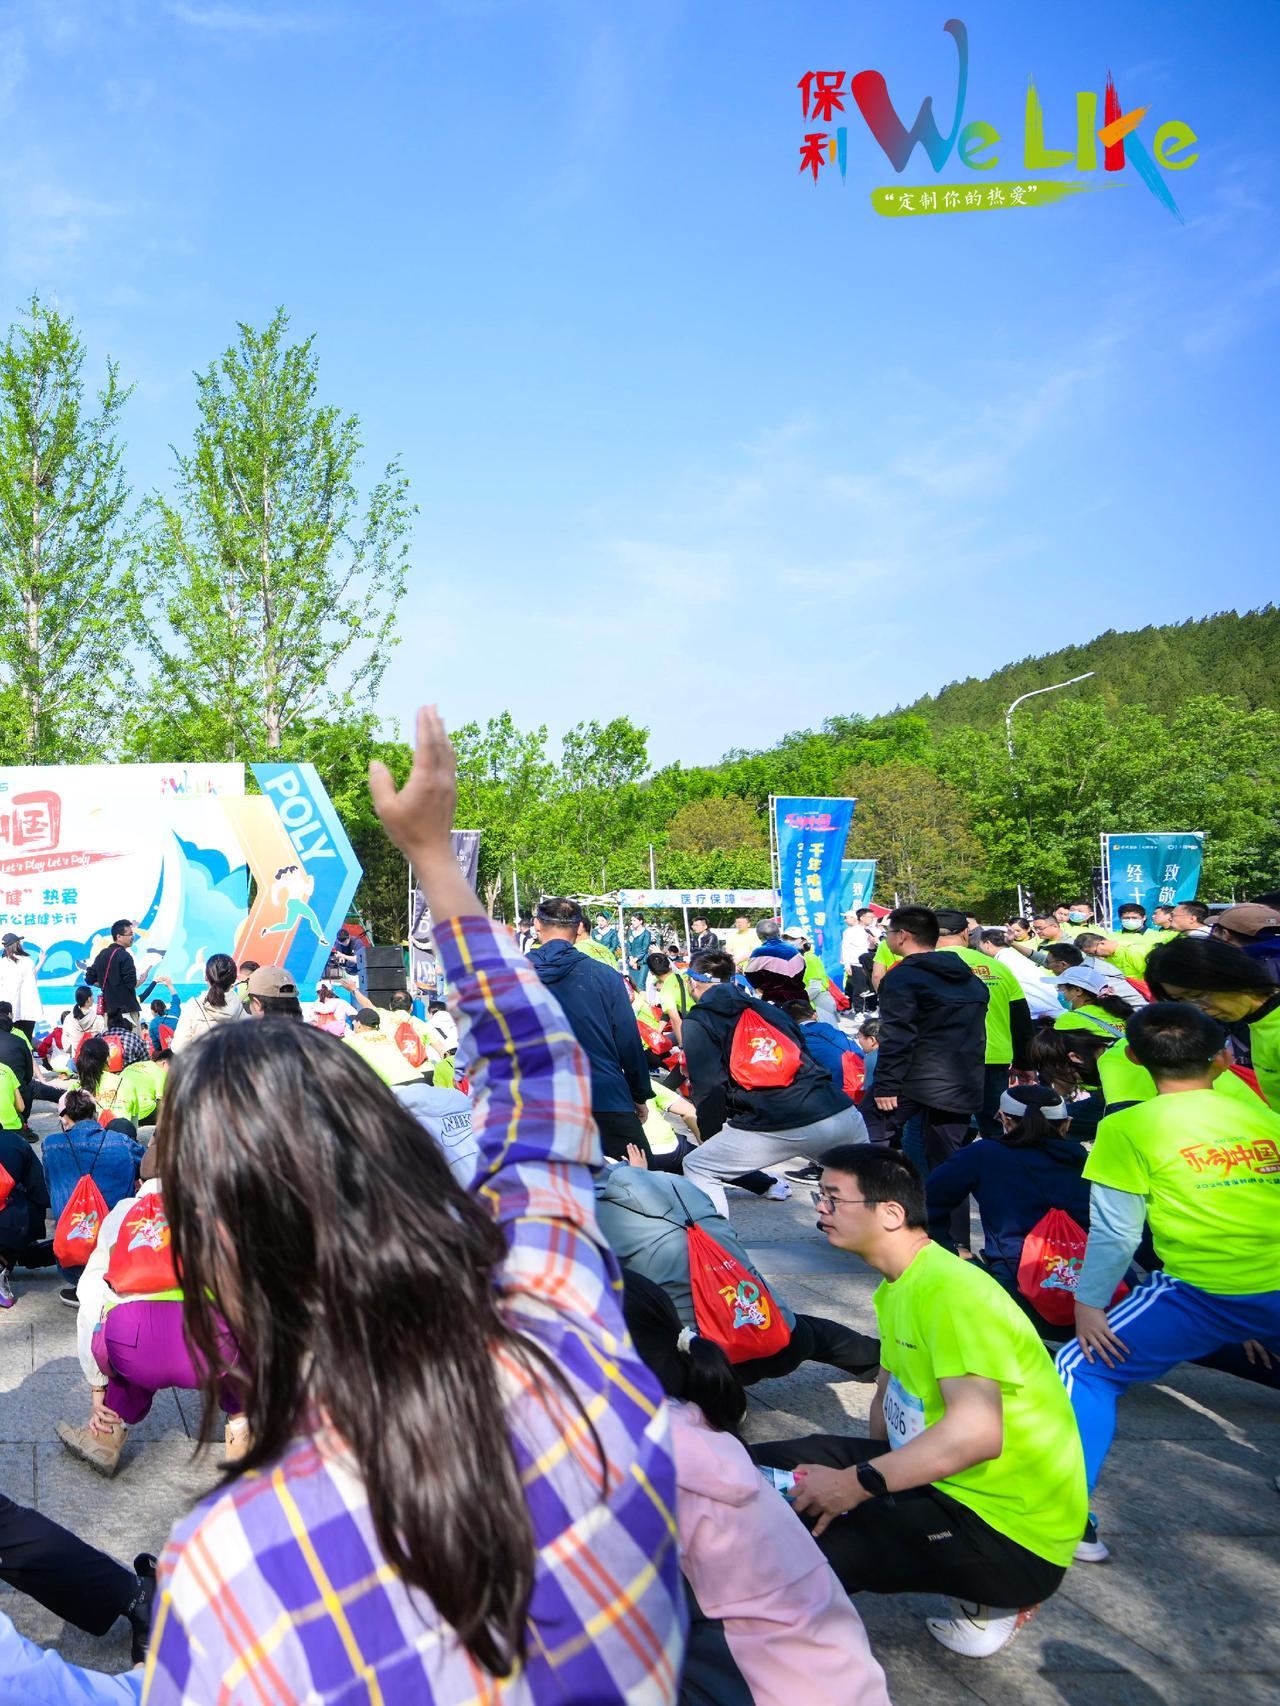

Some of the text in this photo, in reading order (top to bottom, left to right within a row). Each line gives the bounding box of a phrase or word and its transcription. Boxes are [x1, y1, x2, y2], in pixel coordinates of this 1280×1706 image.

[264, 770, 337, 862] POLY
[1, 854, 92, 873] Let's Play Let's Poly
[43, 888, 78, 905] 热爱
[681, 893, 736, 905] 医疗保障
[442, 1113, 472, 1133] NIK
